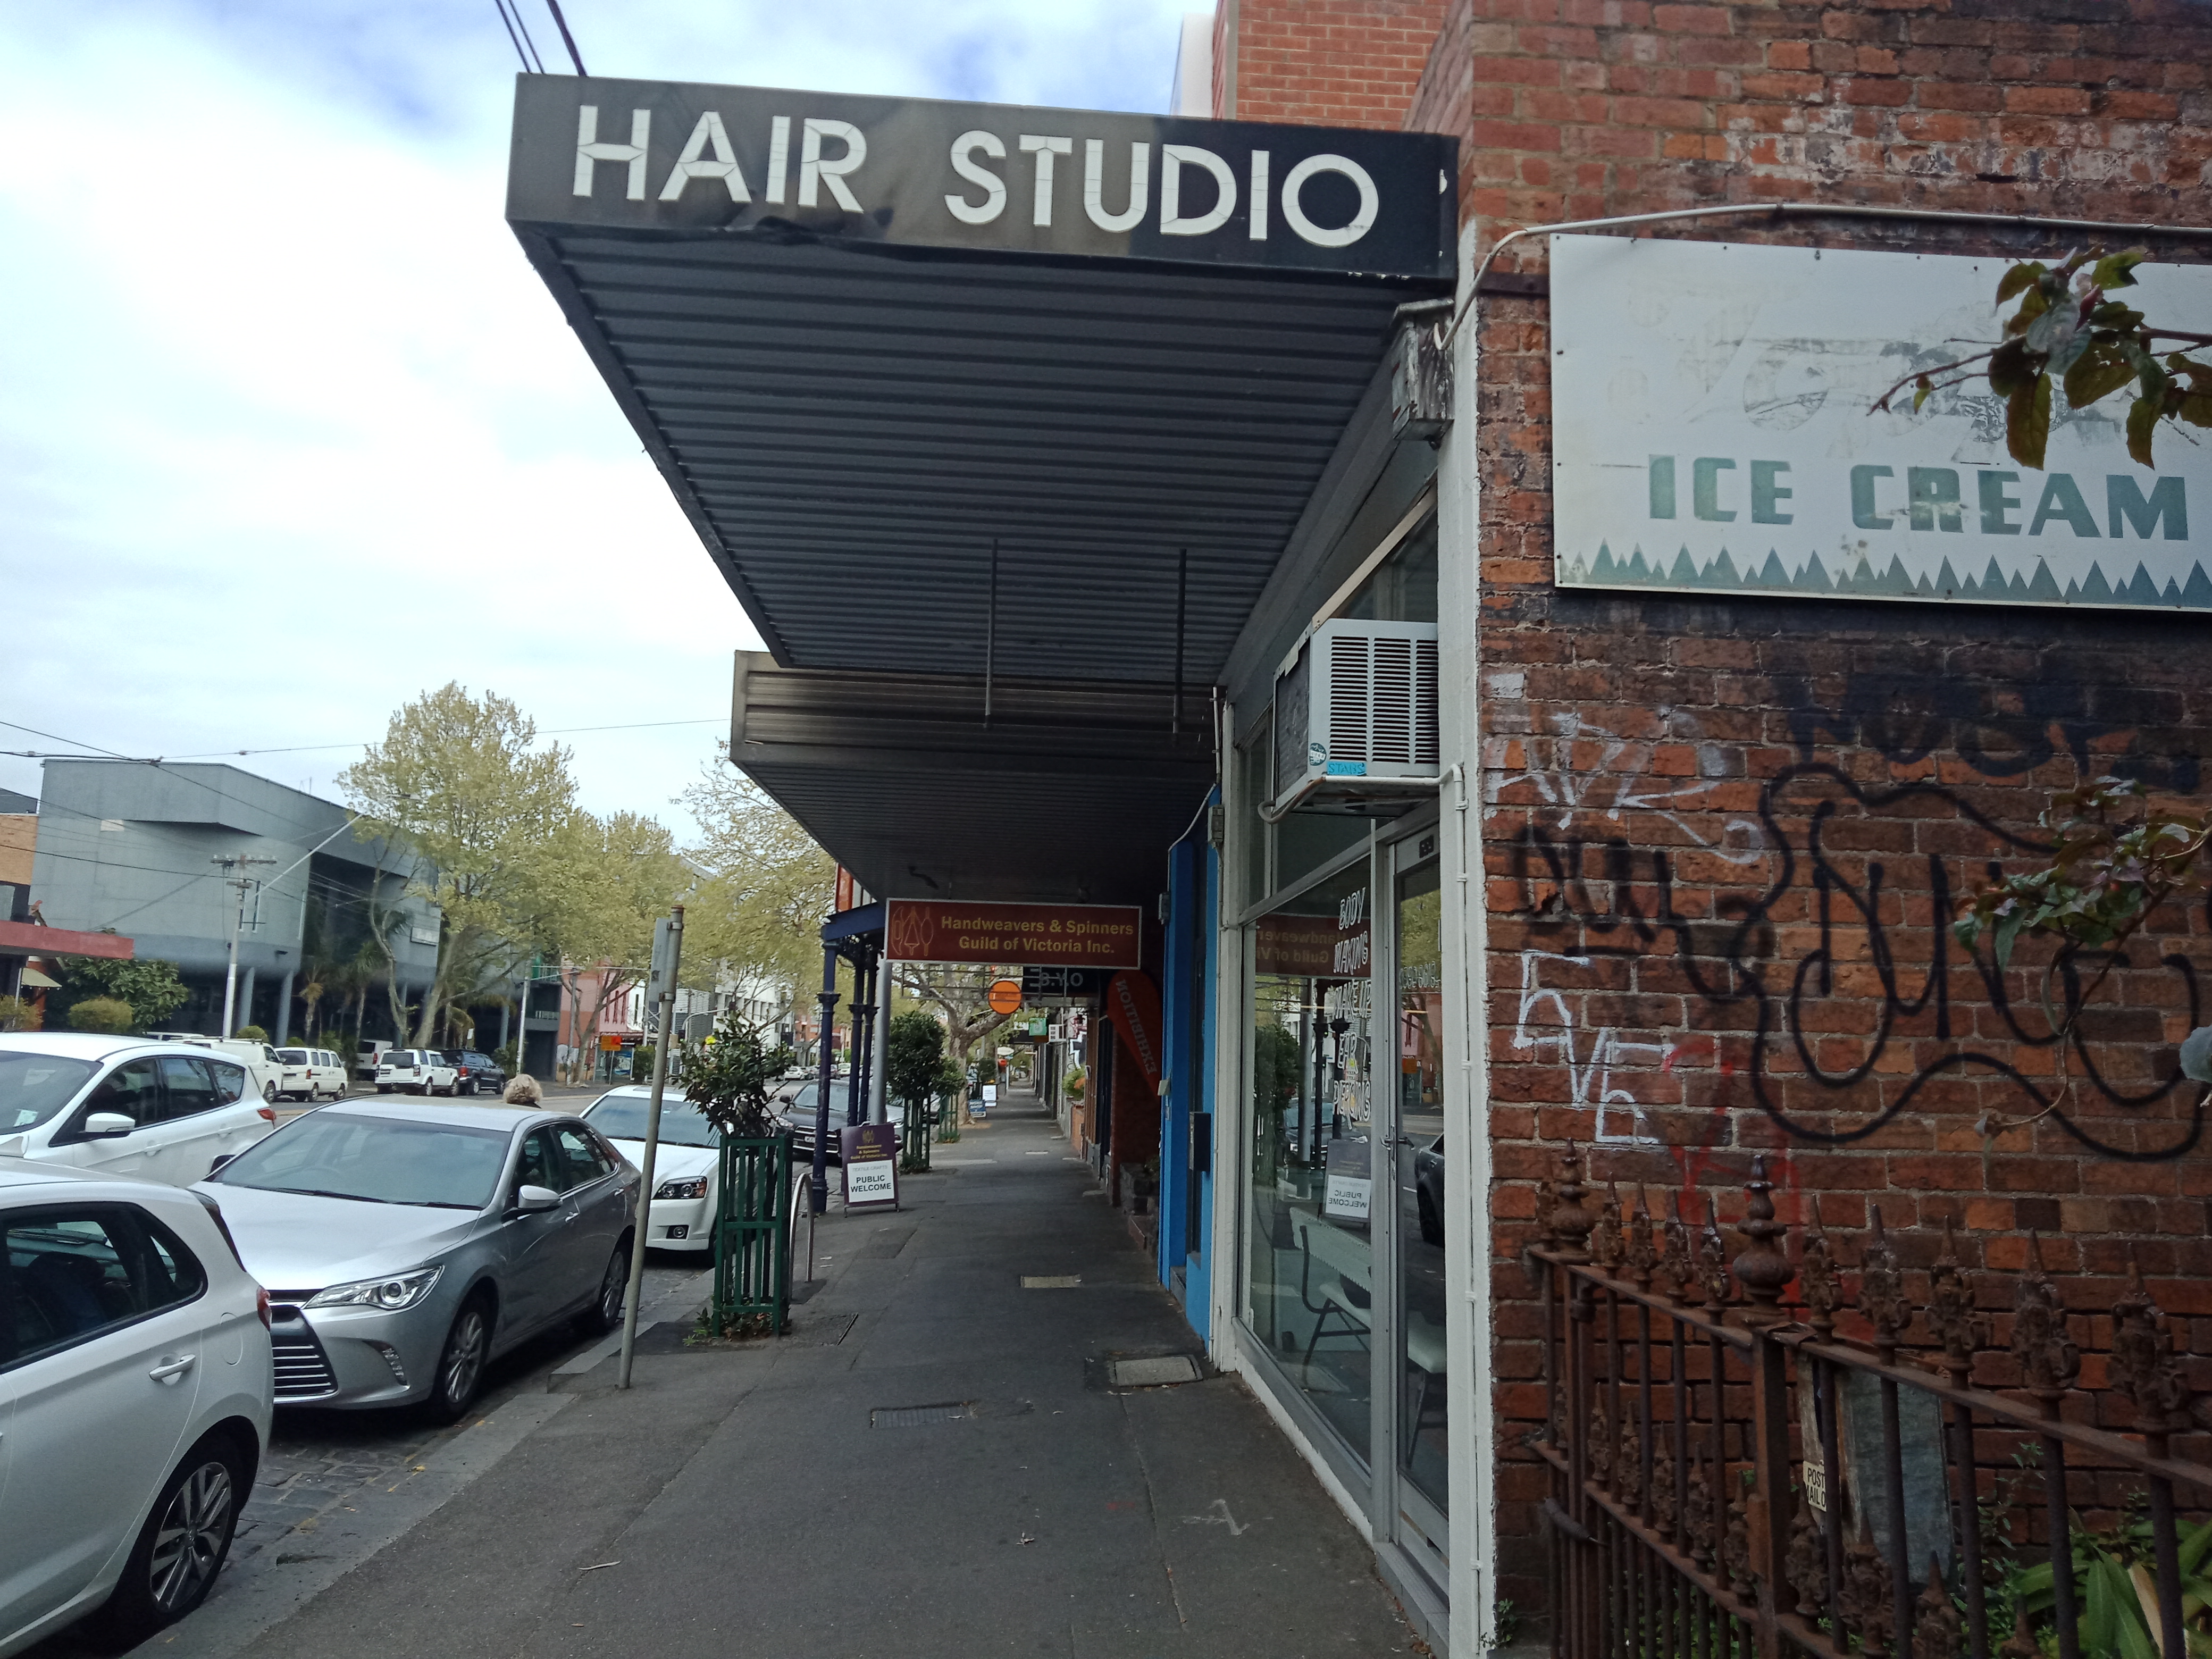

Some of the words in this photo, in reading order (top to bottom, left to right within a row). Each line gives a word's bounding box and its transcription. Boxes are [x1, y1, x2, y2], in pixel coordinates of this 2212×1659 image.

[572, 105, 867, 214] HAIR
[944, 129, 1380, 248] STUDIO
[1648, 454, 1794, 526] ICE
[1850, 464, 2190, 541] CREAM
[941, 916, 1045, 933] Handweavers
[1049, 919, 1062, 933] &
[1066, 920, 1134, 936] Spinners
[1338, 886, 1366, 931] BODY
[959, 936, 999, 950] Guild
[1003, 937, 1019, 951] of
[1023, 938, 1082, 953] Victoria
[1087, 940, 1115, 954] Inc.
[1333, 931, 1368, 975] WAXING
[1337, 1032, 1359, 1075] EAR
[1332, 1080, 1371, 1130] PIERCING
[850, 1183, 892, 1193] WELCOME
[1807, 1467, 1825, 1489] POST
[1807, 1485, 1821, 1505] AIL
